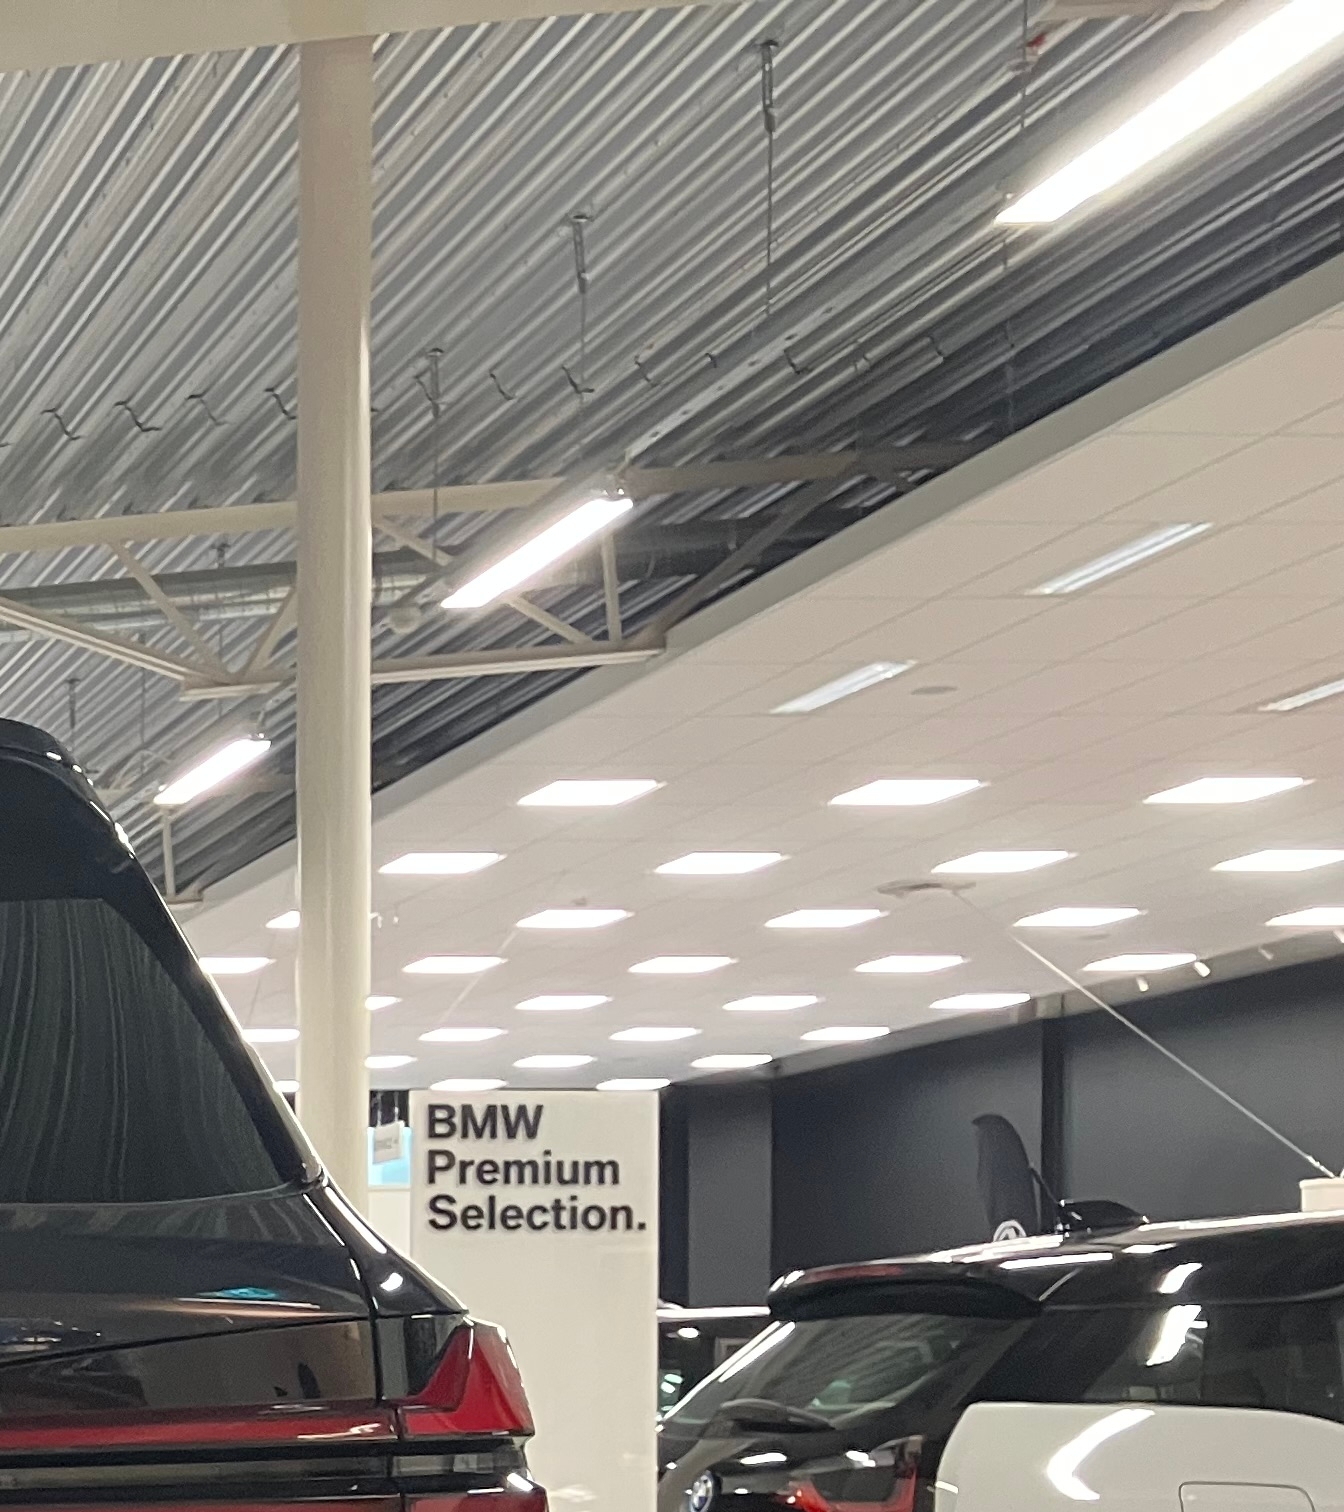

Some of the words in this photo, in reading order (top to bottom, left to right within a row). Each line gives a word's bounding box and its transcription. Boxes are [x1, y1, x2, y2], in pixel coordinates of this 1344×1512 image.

[426, 1103, 544, 1140] BMW
[426, 1149, 620, 1186] Premium
[427, 1194, 648, 1231] Selection.
